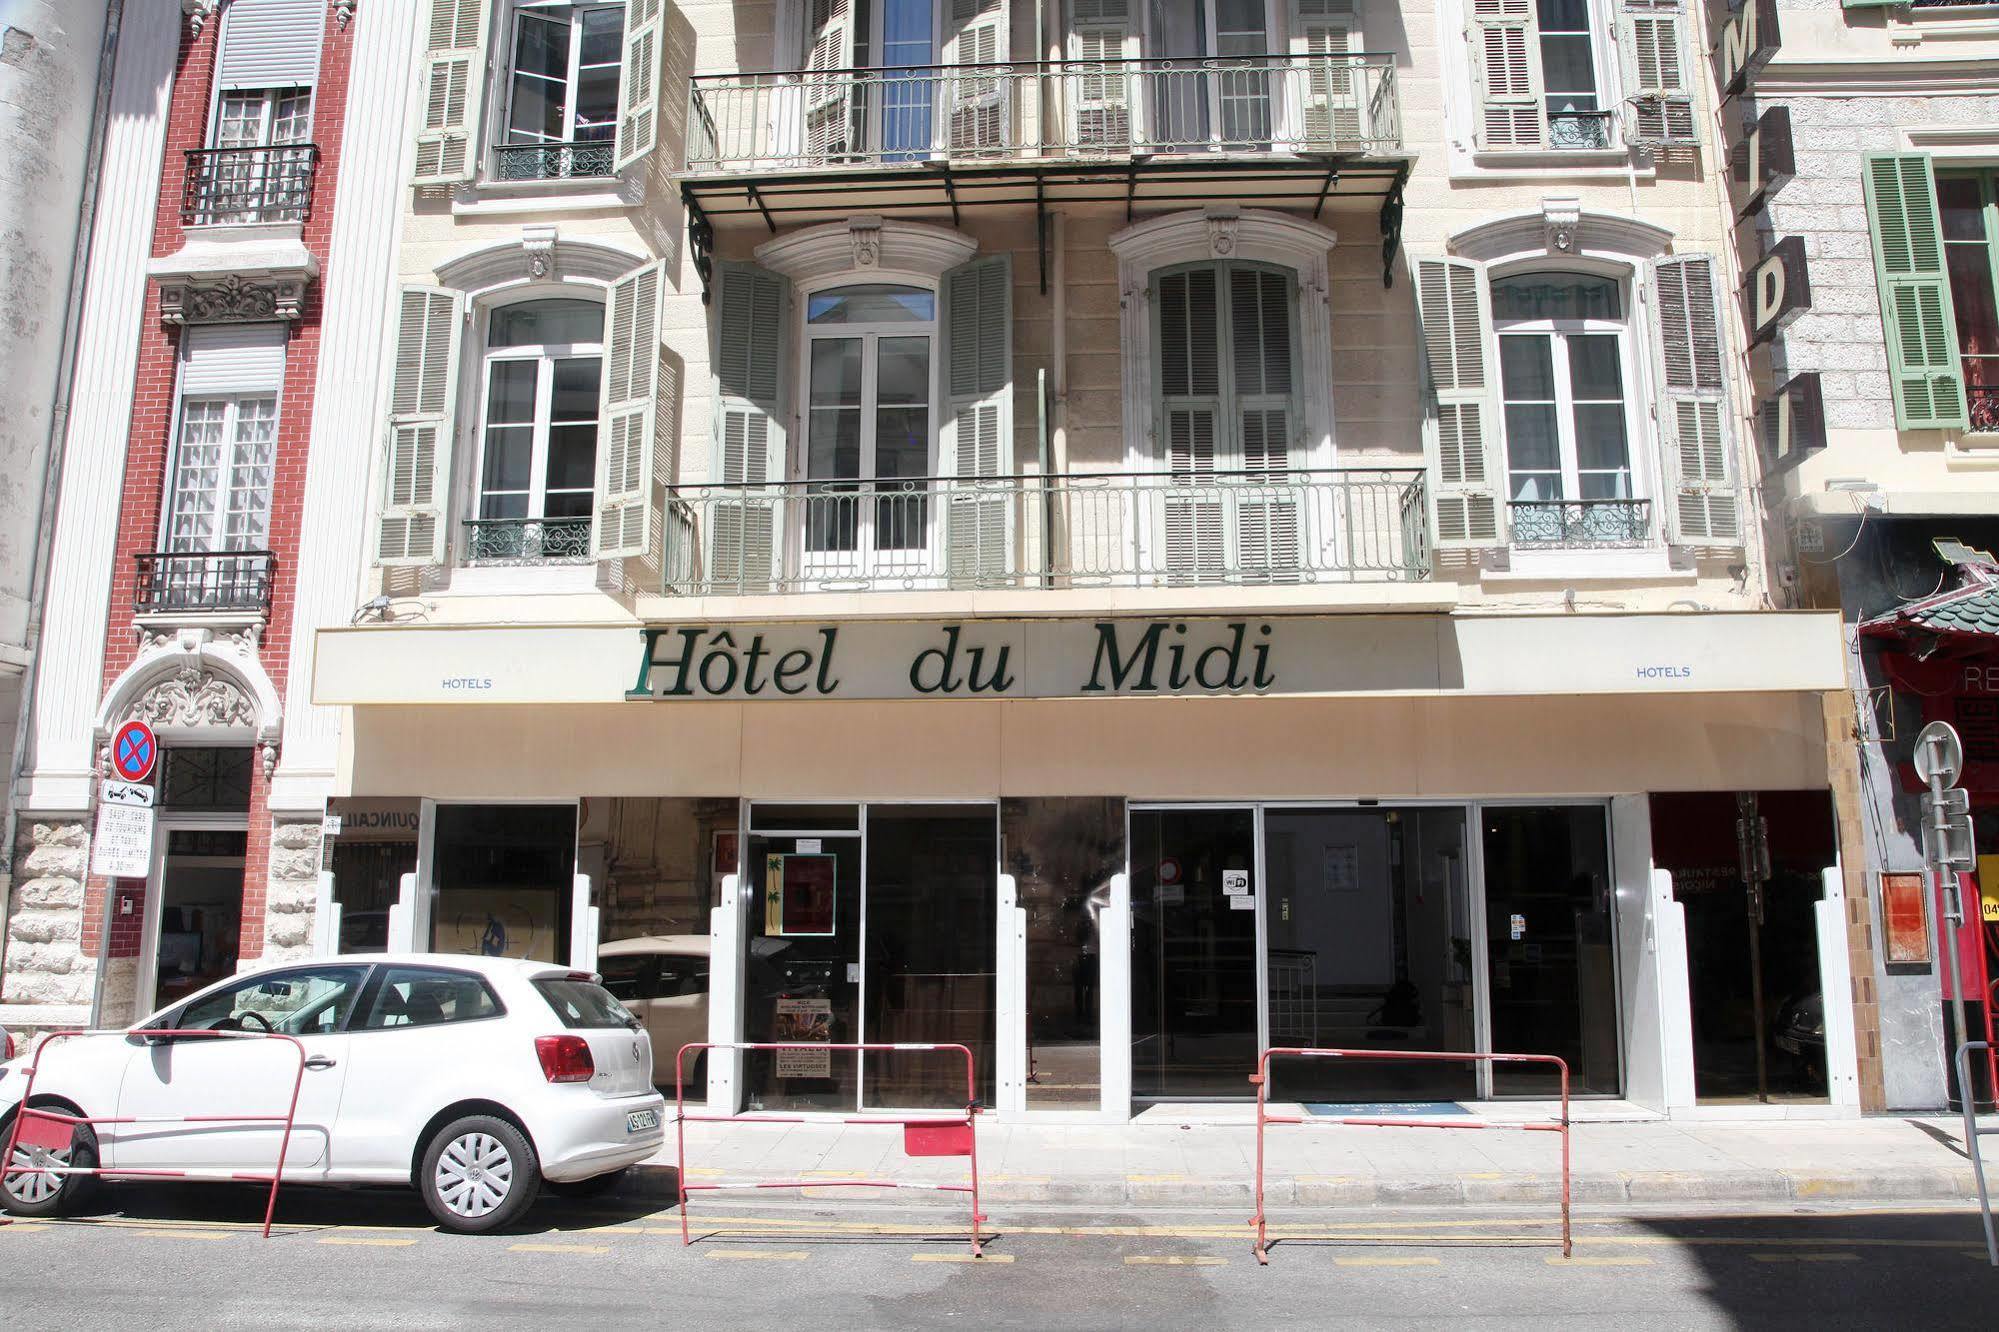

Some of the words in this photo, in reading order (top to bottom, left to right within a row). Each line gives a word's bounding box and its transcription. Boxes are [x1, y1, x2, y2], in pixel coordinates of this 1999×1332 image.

[625, 627, 839, 696] Hôtel
[909, 626, 1015, 693] du
[1080, 623, 1275, 692] Midi
[1637, 667, 1690, 678] HOTELS
[1964, 666, 1999, 692] RE
[442, 679, 491, 689] HOTELS
